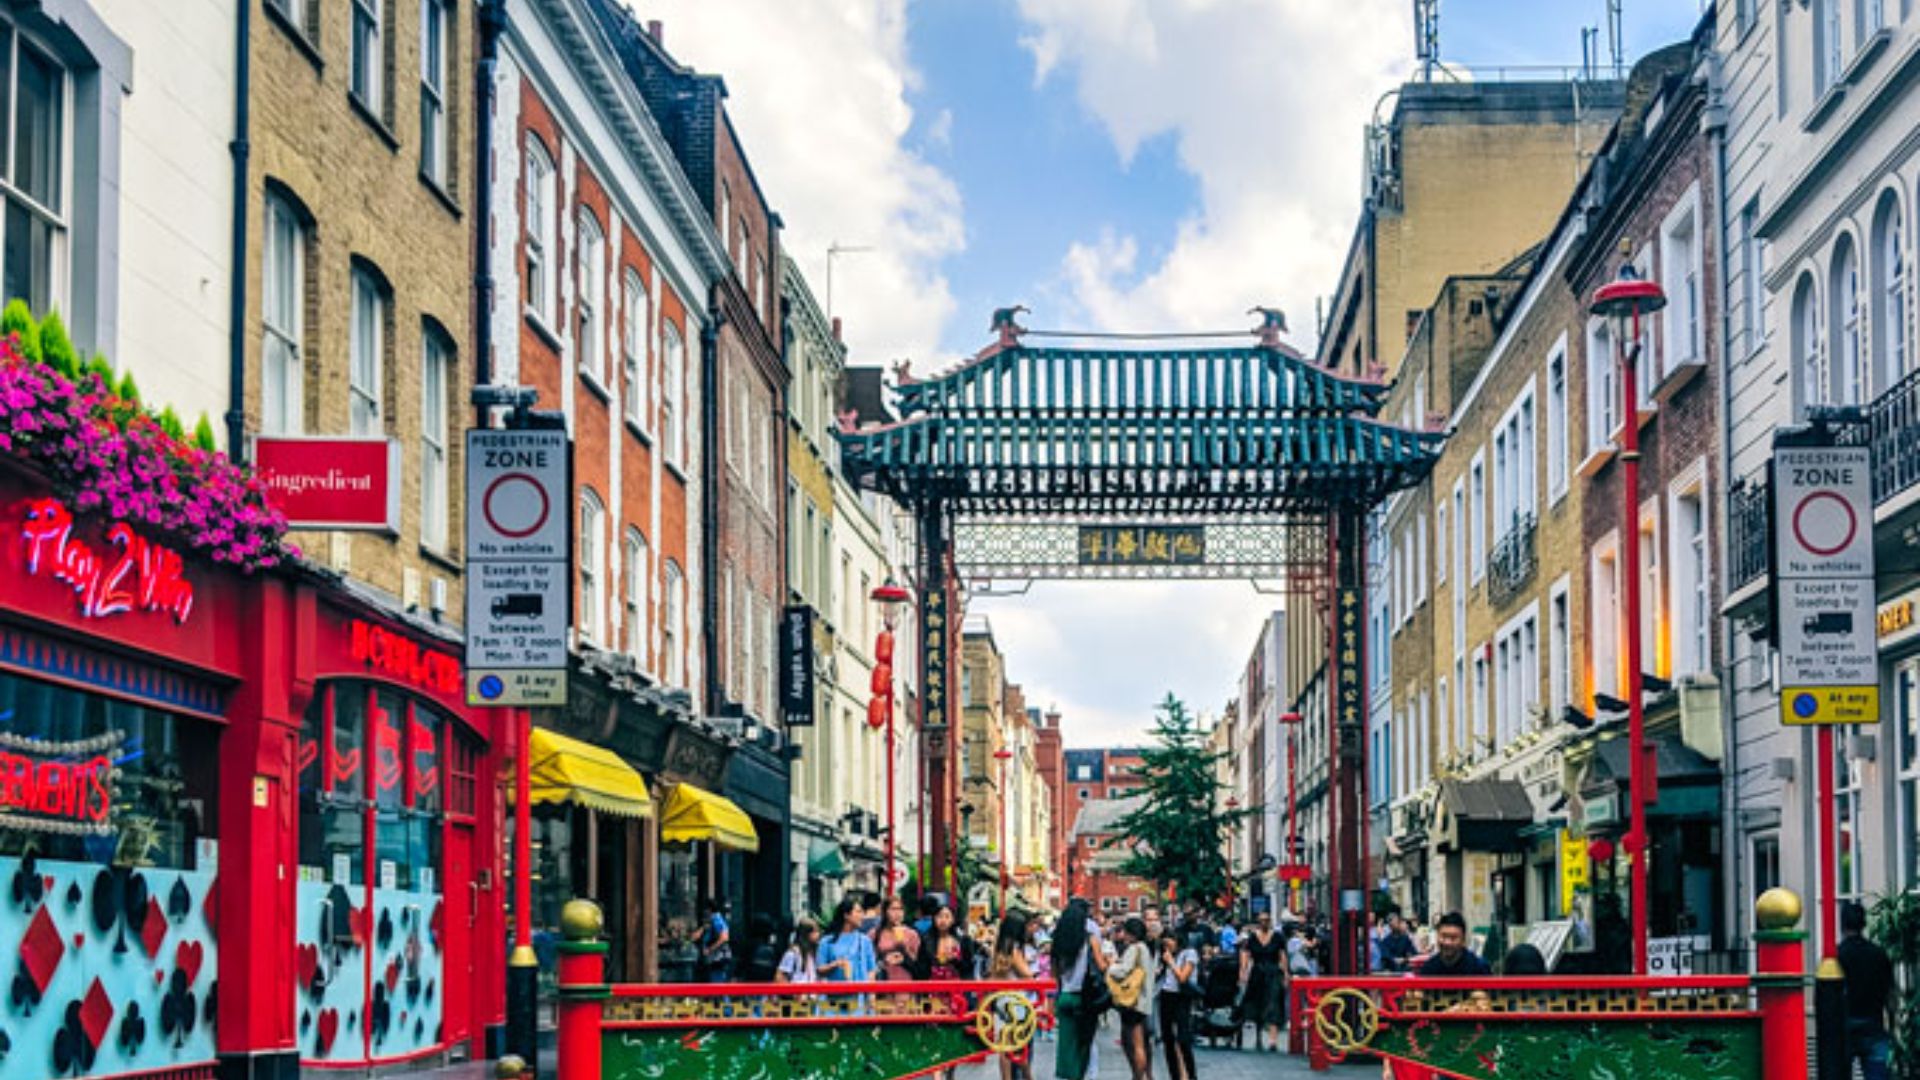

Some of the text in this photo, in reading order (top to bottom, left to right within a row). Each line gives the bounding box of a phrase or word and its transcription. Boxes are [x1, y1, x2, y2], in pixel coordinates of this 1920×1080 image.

[472, 434, 560, 447] PEDESTRIAN
[485, 450, 547, 468] ZONE
[1780, 452, 1865, 464] PEDESTRIAN
[1793, 468, 1853, 486] ZONE
[479, 542, 553, 554] No vehicles
[95, 522, 136, 616] 2
[483, 565, 549, 577] Except for
[1790, 561, 1861, 571] No vehicles
[483, 579, 549, 591] loading by
[1795, 582, 1859, 594] Except for
[1794, 596, 1858, 608] loading by
[489, 623, 545, 635] between
[474, 636, 500, 648] 7am
[513, 636, 526, 648] 12
[530, 638, 561, 648] noon
[1801, 642, 1855, 653] between
[486, 650, 512, 661] Mon
[524, 650, 548, 661] Sun
[1786, 655, 1813, 666] 7am
[1824, 655, 1838, 665] 12
[1840, 656, 1872, 665] noon
[1799, 669, 1824, 679] Mon
[1835, 668, 1860, 679] Sun
[515, 674, 557, 687] At any
[522, 689, 550, 699] time
[1828, 692, 1869, 706] At any
[1835, 707, 1862, 716] time
